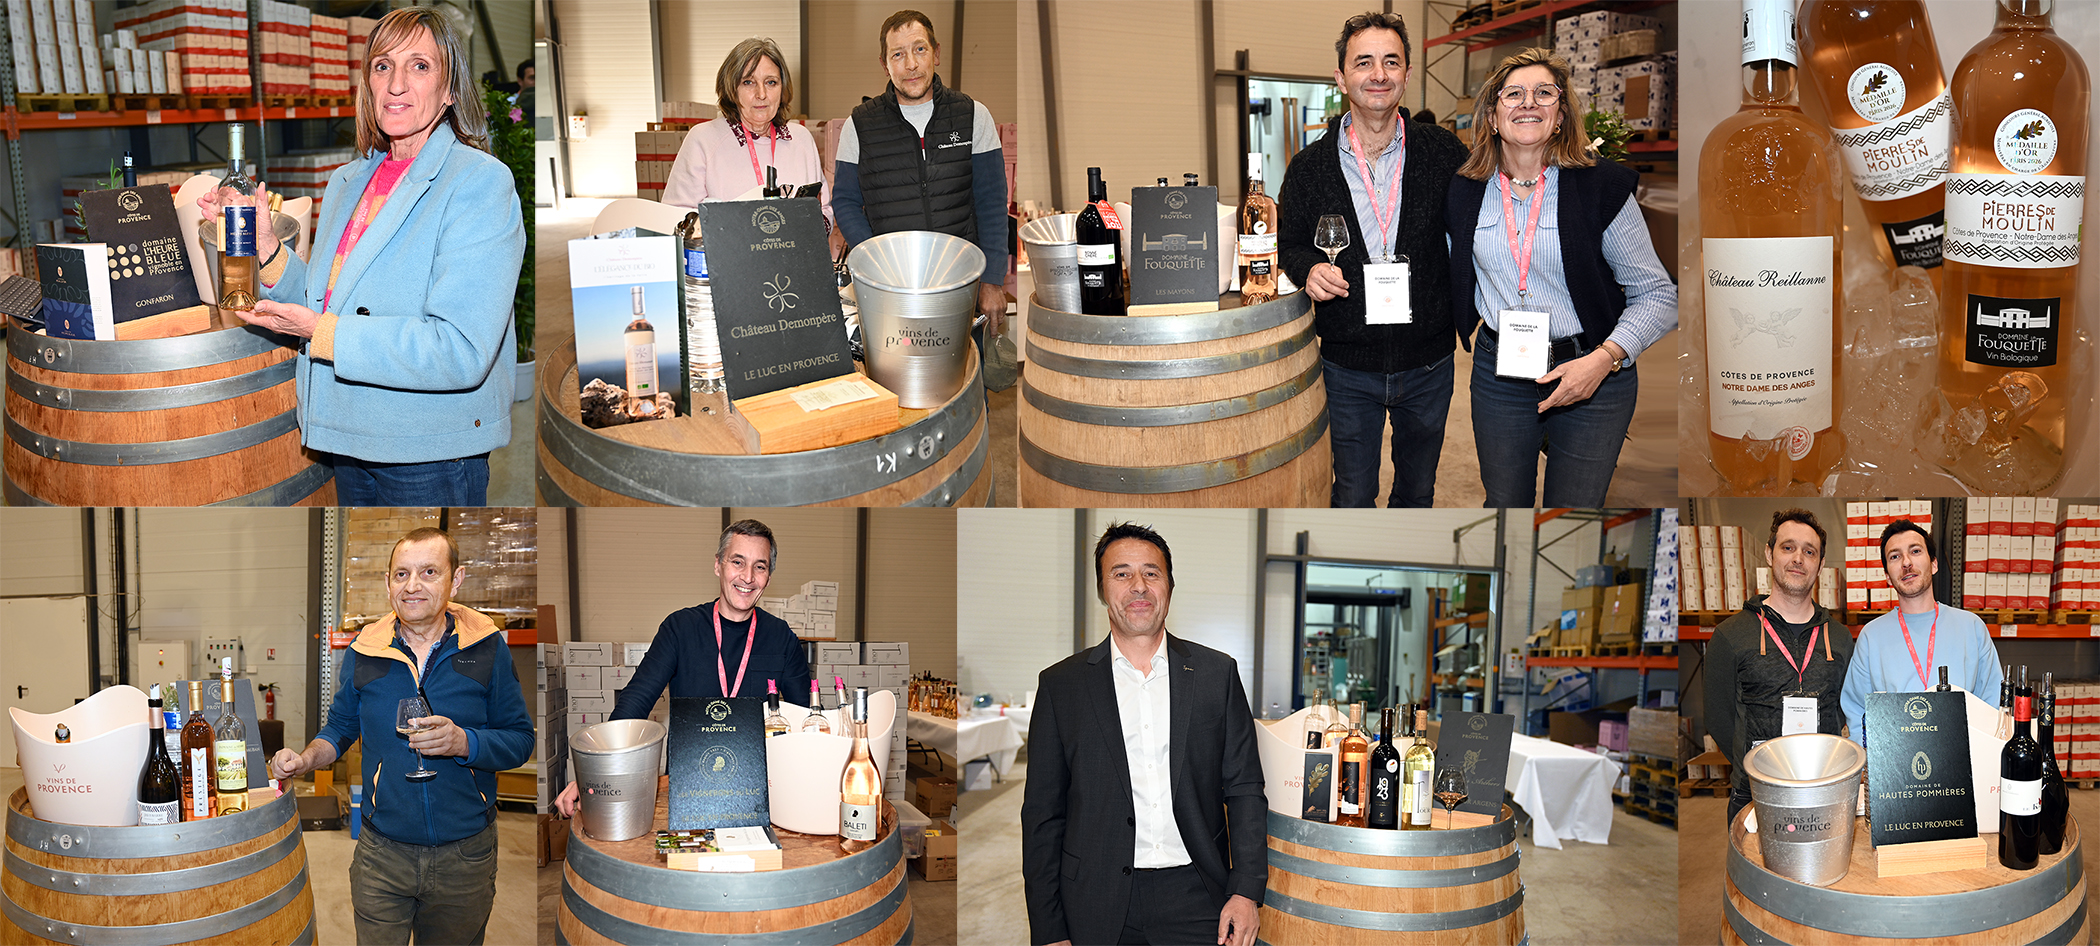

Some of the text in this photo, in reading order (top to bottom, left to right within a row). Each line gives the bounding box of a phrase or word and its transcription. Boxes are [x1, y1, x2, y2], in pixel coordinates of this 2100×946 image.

[1860, 87, 1897, 103] MÉDAILLE
[1870, 97, 1890, 108] D'OR
[1916, 136, 1926, 147] DE
[2006, 140, 2049, 149] MÉDAILLE
[2015, 148, 2038, 156] D'OR
[2045, 207, 2056, 215] DE
[118, 214, 151, 224] PROVENCE
[1952, 227, 1966, 236] Côtes
[1975, 230, 2008, 239] Provence
[2014, 232, 2056, 241] Notre-Dame
[2057, 233, 2067, 241] des
[142, 237, 177, 248] domaine
[750, 241, 796, 251] PROVENCE
[143, 243, 179, 256] L'HEURE
[146, 251, 181, 265] BLEUE
[148, 261, 174, 271] vignoble
[1145, 258, 1205, 271] FOUQUETTE
[1708, 269, 1827, 288] Château Reillanne
[136, 294, 174, 308] GONFARON
[731, 312, 837, 339] Château Demonpère
[899, 326, 938, 338] vins de
[1978, 333, 2047, 353] FOUQUETTE
[1986, 351, 2038, 363] Vin Biologique
[744, 353, 840, 380] LE LUC EN PROVENCE
[1721, 371, 1747, 380] CÔTES
[1766, 368, 1815, 380] PROVENCE
[1722, 383, 1745, 392] NOTRE
[1772, 384, 1788, 392] DES
[1790, 380, 1815, 390] ANGES
[37, 784, 92, 793] PROVENCE
[586, 780, 611, 789] vins de
[1284, 780, 1304, 788] PROV
[1879, 787, 1966, 799] HAUTES POMMIÈRES
[720, 812, 758, 820] PROVENCE
[1784, 814, 1820, 823] vins de
[844, 820, 867, 830] BALETI
[1925, 819, 1964, 829] PROVENCE
